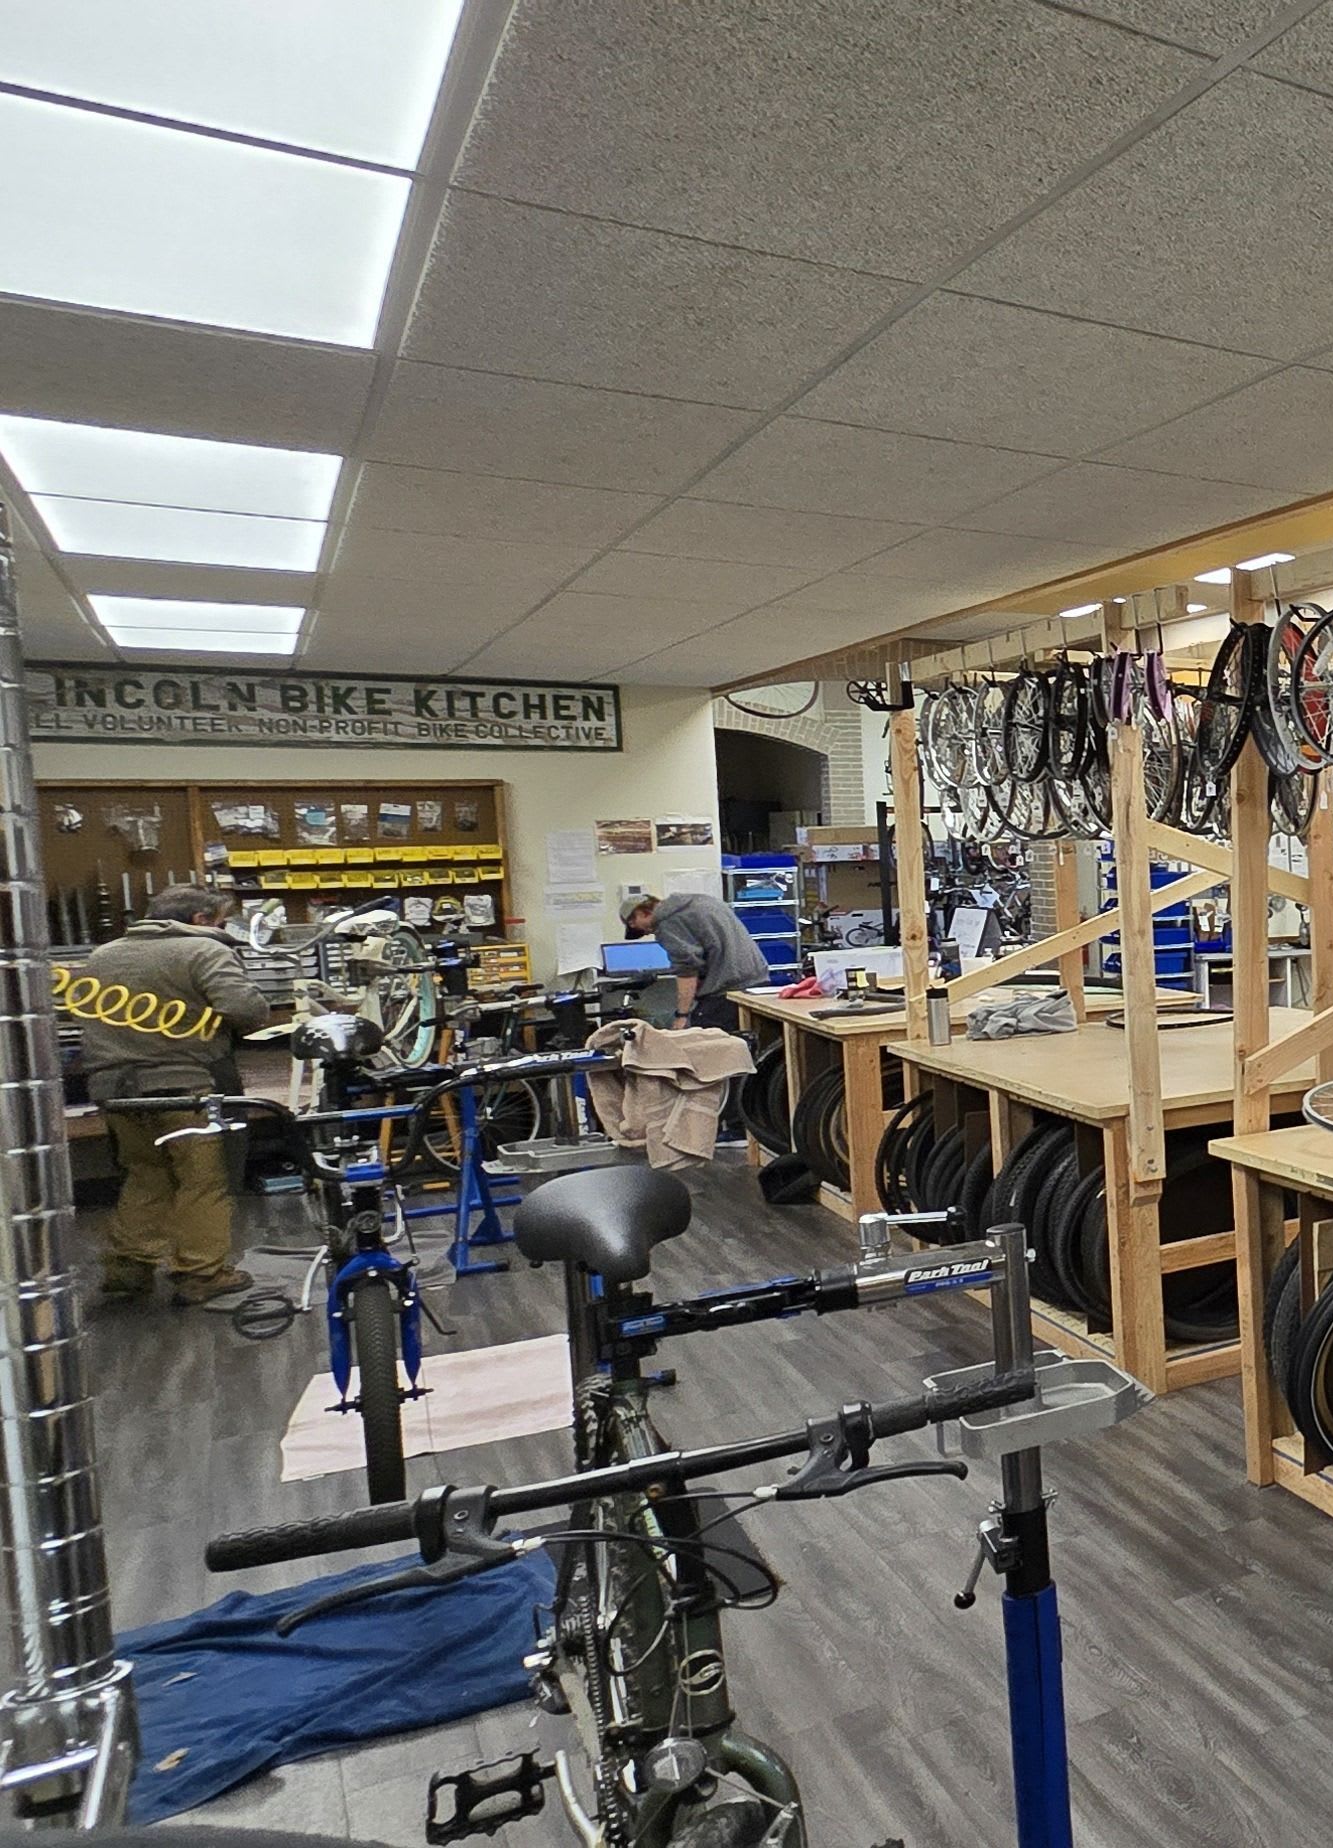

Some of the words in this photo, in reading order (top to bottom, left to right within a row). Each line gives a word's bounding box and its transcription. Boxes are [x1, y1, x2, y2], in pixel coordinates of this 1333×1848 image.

[52, 676, 257, 711] INCOLN
[280, 682, 393, 716] BIKE
[413, 687, 606, 722] KITCHEN
[28, 712, 73, 729] LL
[83, 713, 242, 733] VOLUNTEER
[258, 717, 401, 738] NON-PROFIT
[416, 722, 468, 738] BIKE
[474, 724, 606, 741] COLLECTIVE
[907, 1266, 950, 1283] Park
[950, 1258, 990, 1275] Tool
